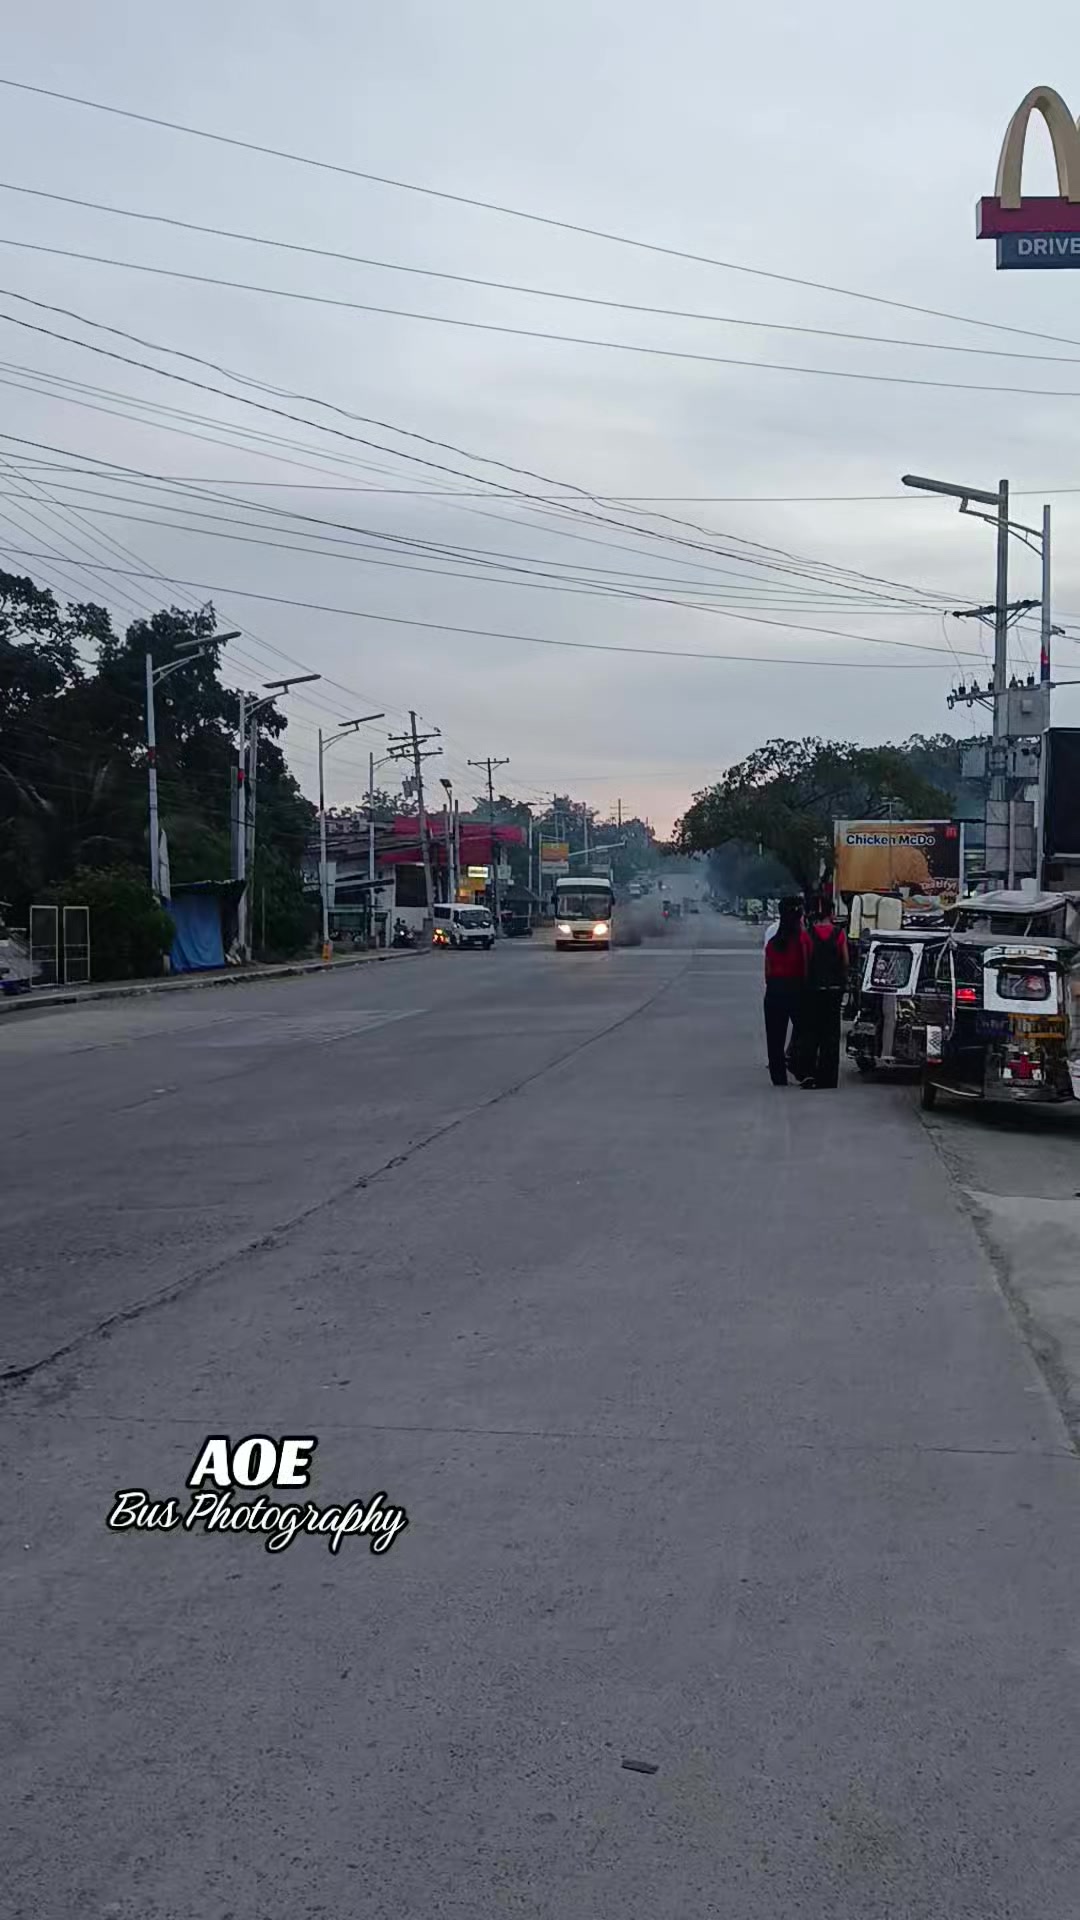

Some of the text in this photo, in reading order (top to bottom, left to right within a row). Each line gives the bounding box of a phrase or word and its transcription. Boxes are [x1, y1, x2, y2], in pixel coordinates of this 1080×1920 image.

[1018, 237, 1080, 255] DRIVE
[846, 834, 936, 846] Chicken McDo
